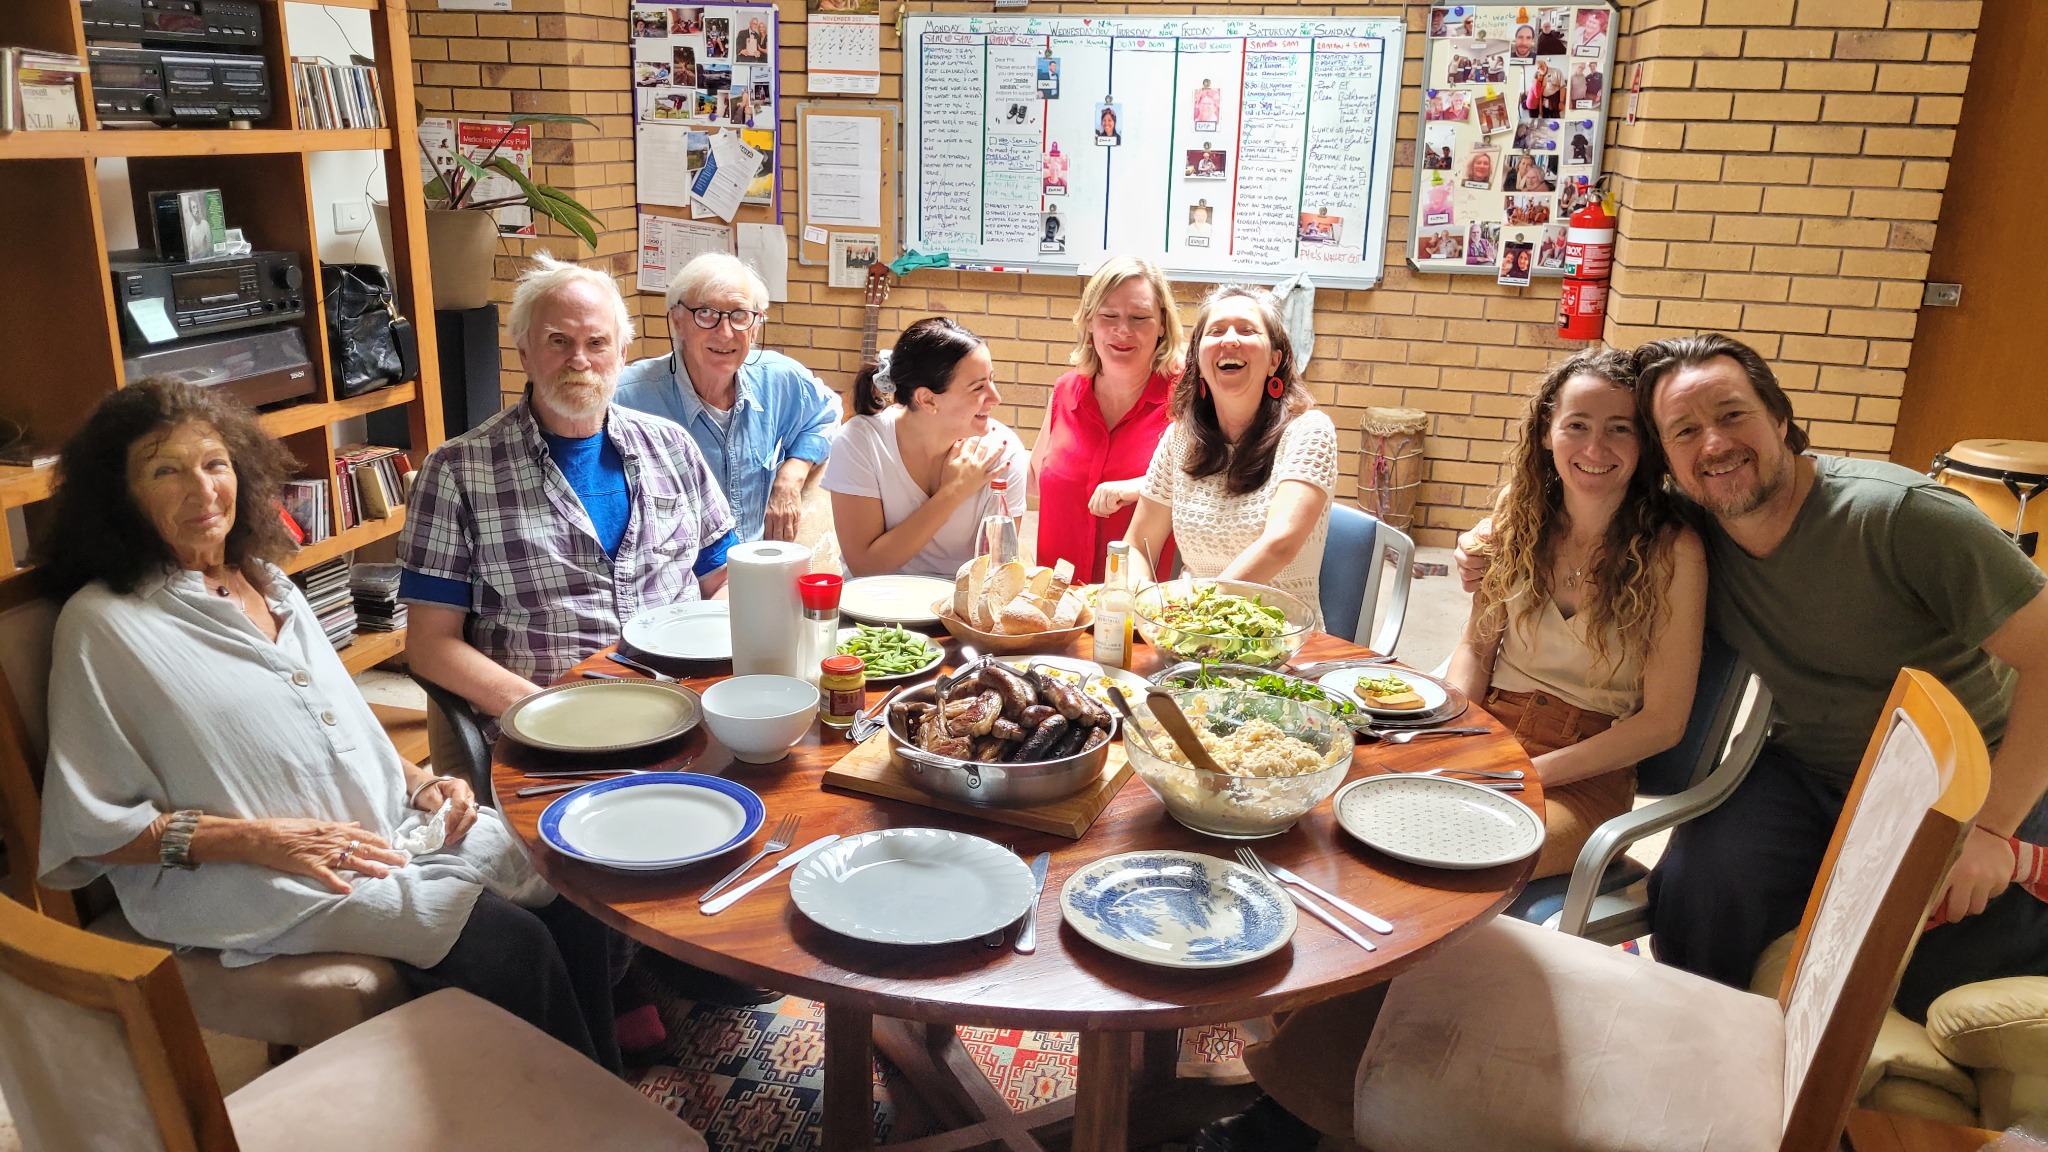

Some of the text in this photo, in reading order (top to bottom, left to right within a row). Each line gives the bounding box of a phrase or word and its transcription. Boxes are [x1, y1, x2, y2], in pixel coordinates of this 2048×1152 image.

[924, 20, 961, 33] MONDAY
[987, 21, 1020, 33] TUESDAY
[1049, 21, 1095, 36] WEDNESDAY
[1113, 23, 1152, 36] THURSDAY
[1181, 22, 1214, 37] FRIDAY
[1246, 22, 1298, 37] SATURDAY
[1314, 24, 1356, 36] SUNDAY
[463, 135, 483, 143] Medical
